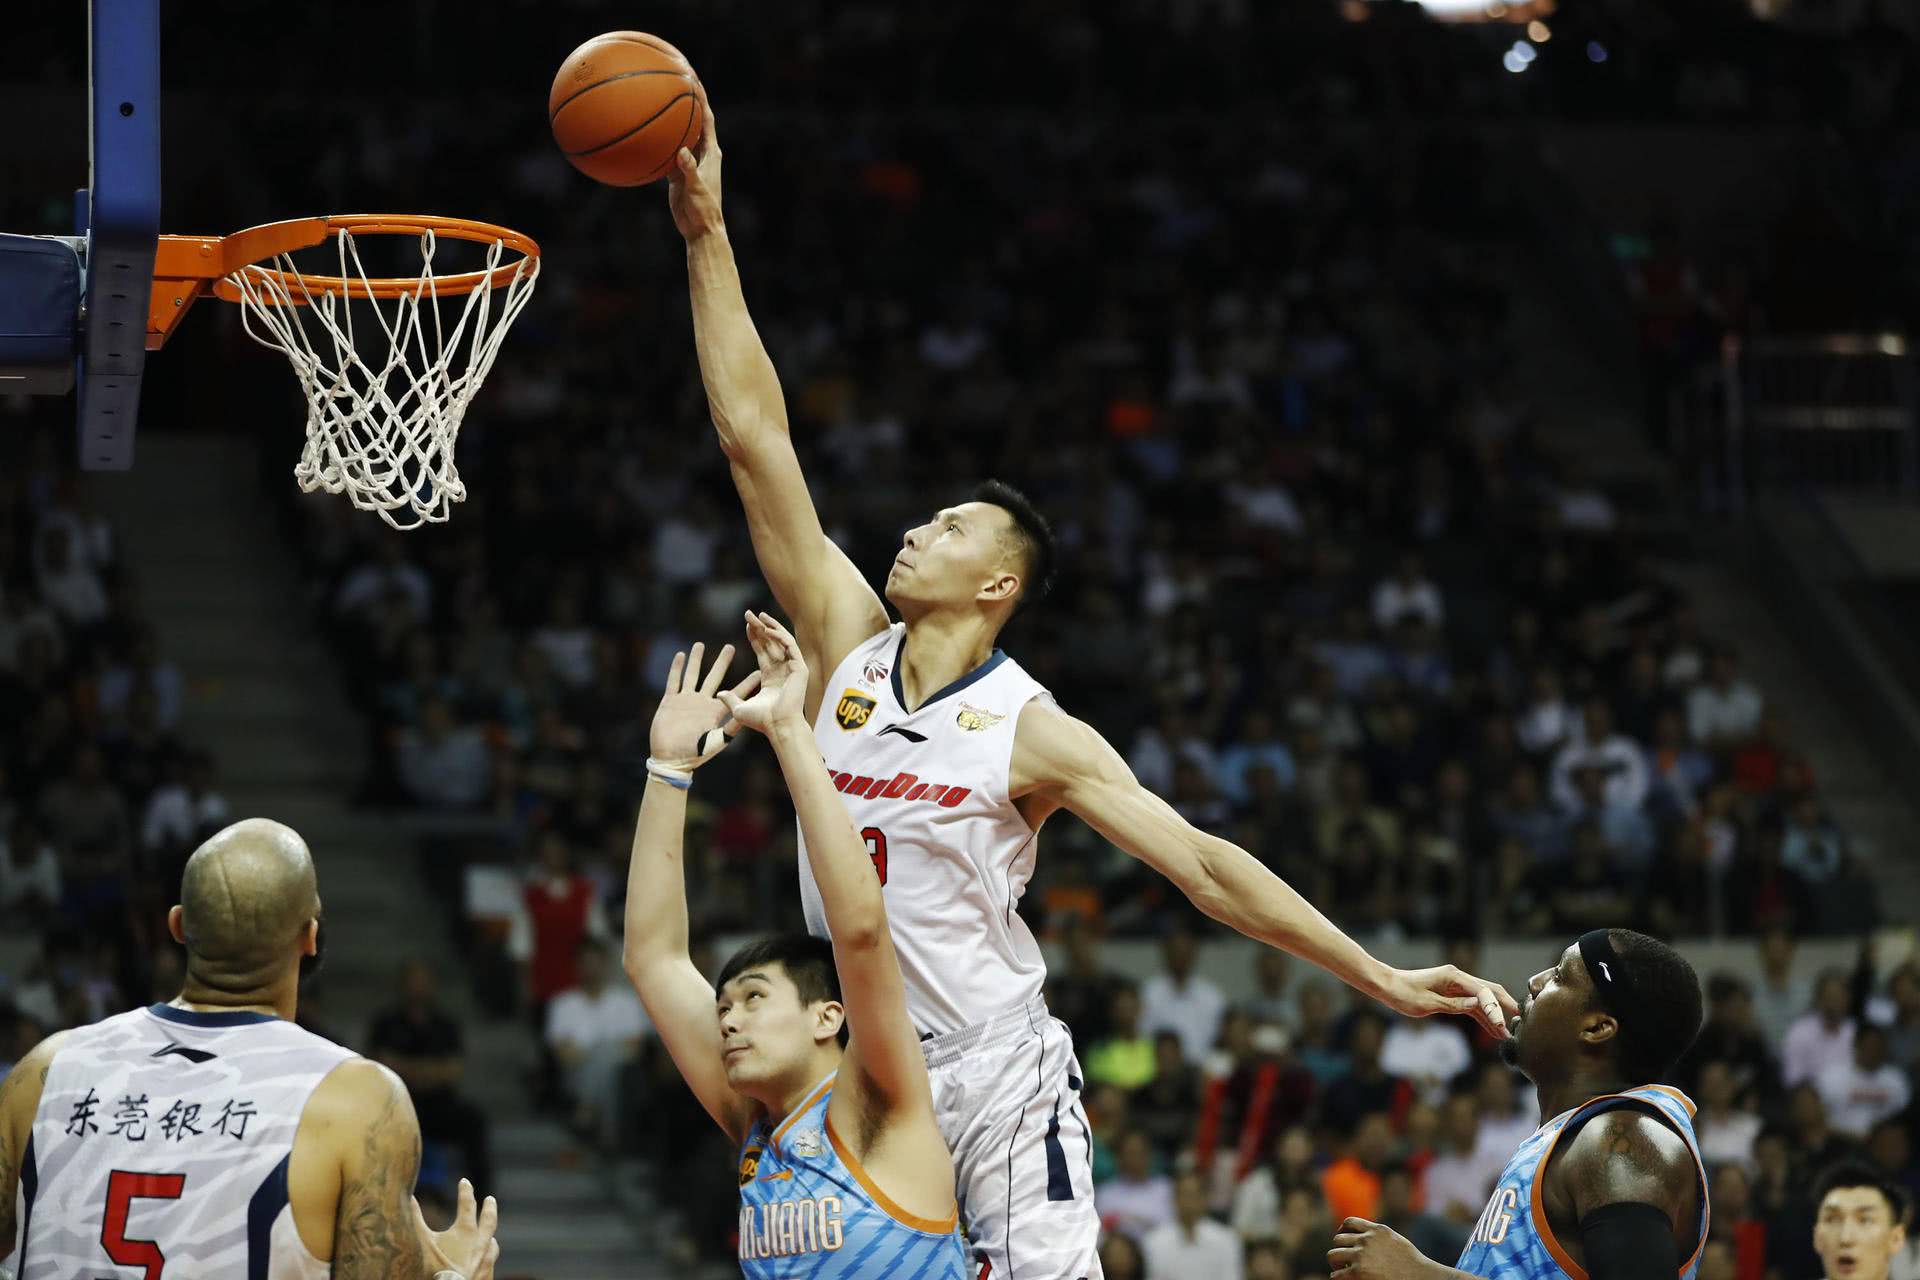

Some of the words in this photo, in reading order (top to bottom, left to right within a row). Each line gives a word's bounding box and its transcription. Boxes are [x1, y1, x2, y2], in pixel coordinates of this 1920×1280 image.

[838, 698, 871, 724] ups
[826, 768, 972, 808] angDong
[65, 1087, 258, 1143] 东莞银行
[96, 1168, 187, 1280] 5
[738, 1196, 844, 1260] INJIANG
